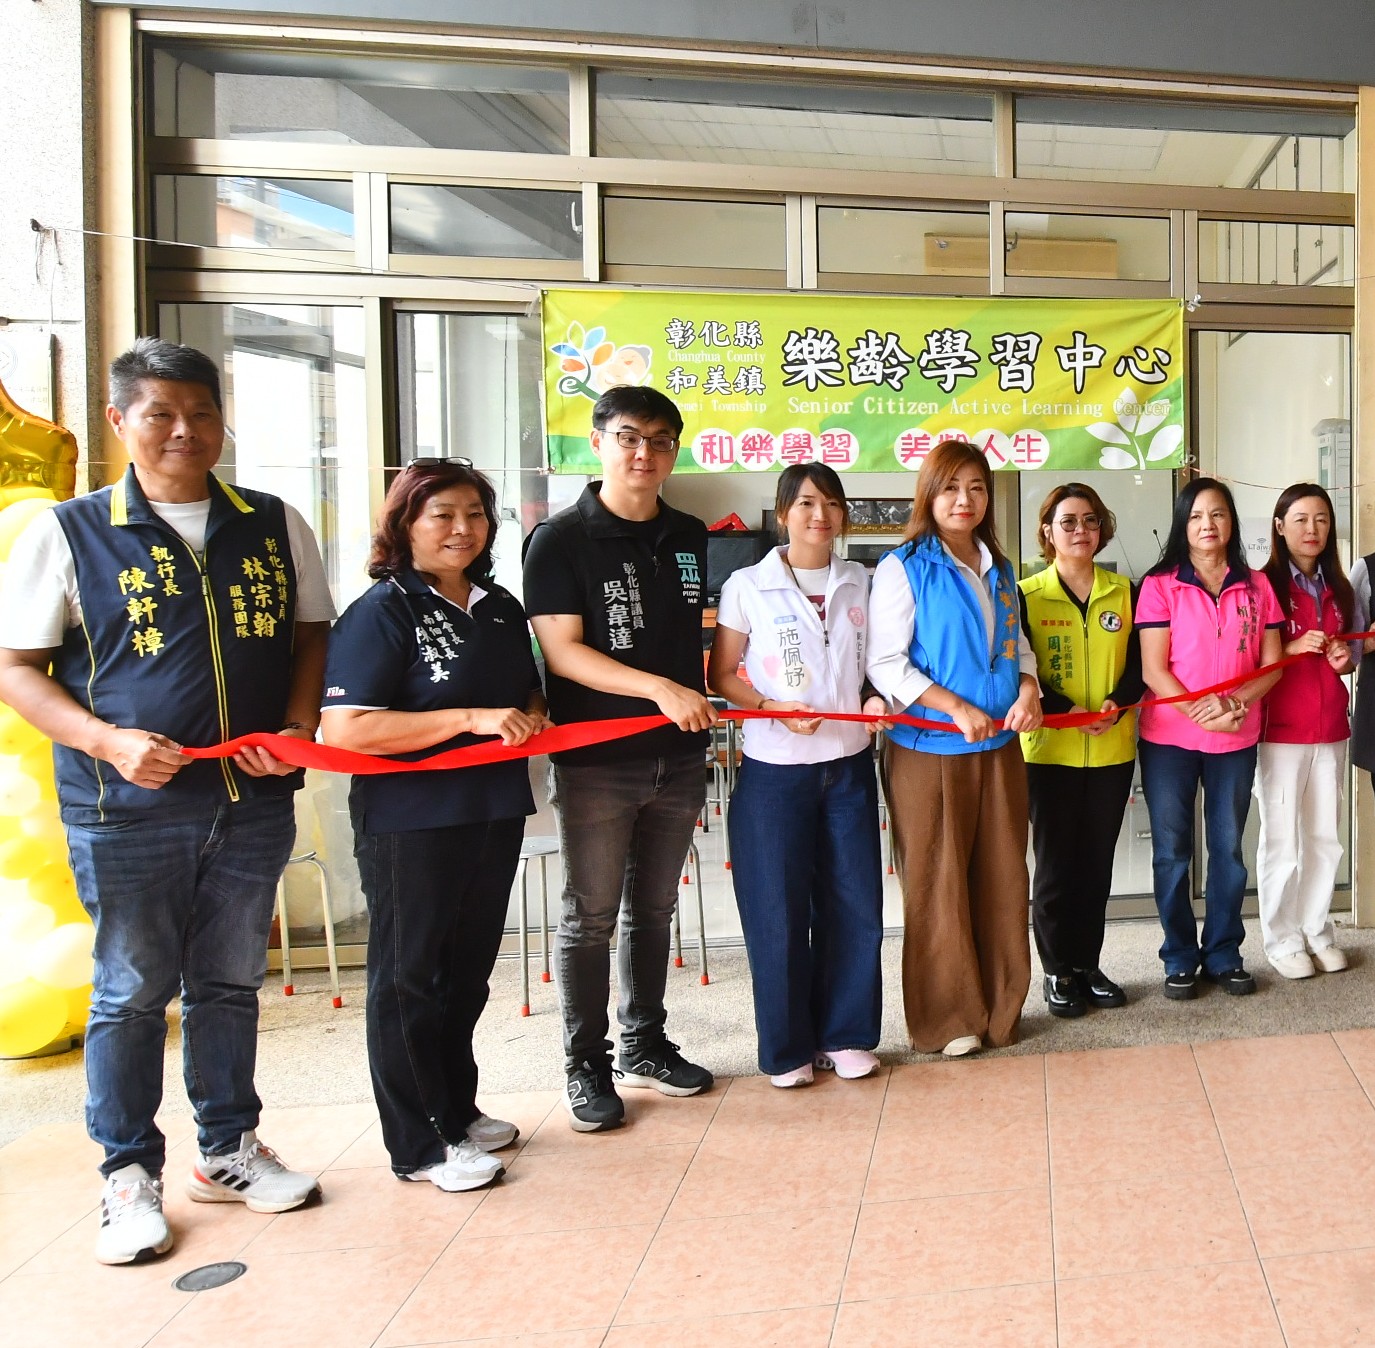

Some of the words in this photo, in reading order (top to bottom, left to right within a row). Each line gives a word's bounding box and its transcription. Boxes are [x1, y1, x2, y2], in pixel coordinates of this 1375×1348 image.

[665, 318, 764, 349] 彰化縣
[668, 350, 721, 363] Changhua
[727, 350, 766, 364] County
[666, 365, 766, 396] 和美鎮
[782, 327, 1172, 395] 樂齡學習中心
[675, 399, 704, 413] emei
[711, 399, 767, 414] Township
[788, 397, 853, 415] Senior
[863, 396, 939, 416] Citizen
[950, 398, 1011, 416] Active
[1022, 398, 1103, 418] Learning
[1112, 398, 1171, 416] Center
[700, 433, 851, 465] 和樂學習
[150, 545, 183, 597] 執行長
[241, 556, 278, 638] 林宗翰
[264, 537, 288, 620] 彰化縣議員
[622, 562, 645, 630] 彰化縣議員
[118, 566, 165, 658] 陳軒樟
[229, 584, 251, 638] 服務團隊
[433, 609, 465, 645] 副會長
[603, 579, 634, 651] 吳韋達
[415, 626, 451, 683] 陳淑美
[777, 627, 805, 688] 施佩妤
